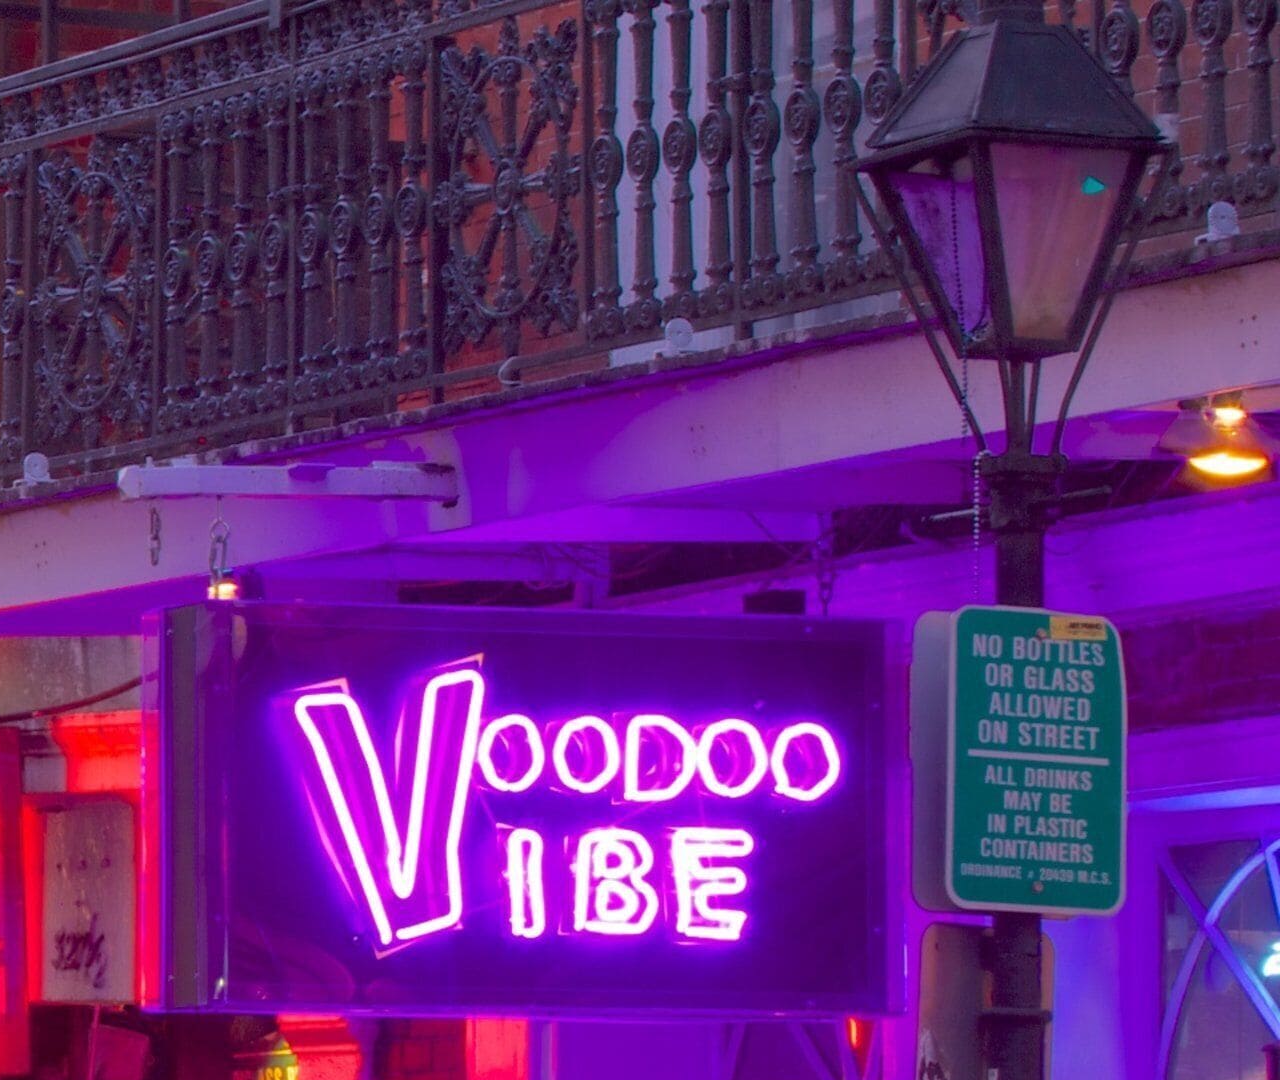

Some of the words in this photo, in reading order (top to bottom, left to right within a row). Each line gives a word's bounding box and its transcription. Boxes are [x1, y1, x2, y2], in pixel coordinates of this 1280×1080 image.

[972, 633, 1003, 659] NO
[1013, 636, 1106, 667] BOTTLES
[984, 662, 1013, 688] OR
[1023, 665, 1095, 694] GLASS
[989, 691, 1091, 722] ALLOWED
[978, 719, 1008, 745] ON
[1018, 721, 1100, 751] STREET
[984, 764, 1017, 787] ALL
[1024, 767, 1094, 792] DRINKS
[295, 668, 841, 945] VOODOO
[1003, 790, 1042, 812] MAY
[1049, 793, 1072, 814] BE
[987, 813, 1007, 834] IN
[1014, 815, 1088, 840] PLASTIC
[980, 838, 1094, 864] CONTAINERS
[961, 862, 1022, 879] ORDINANCE
